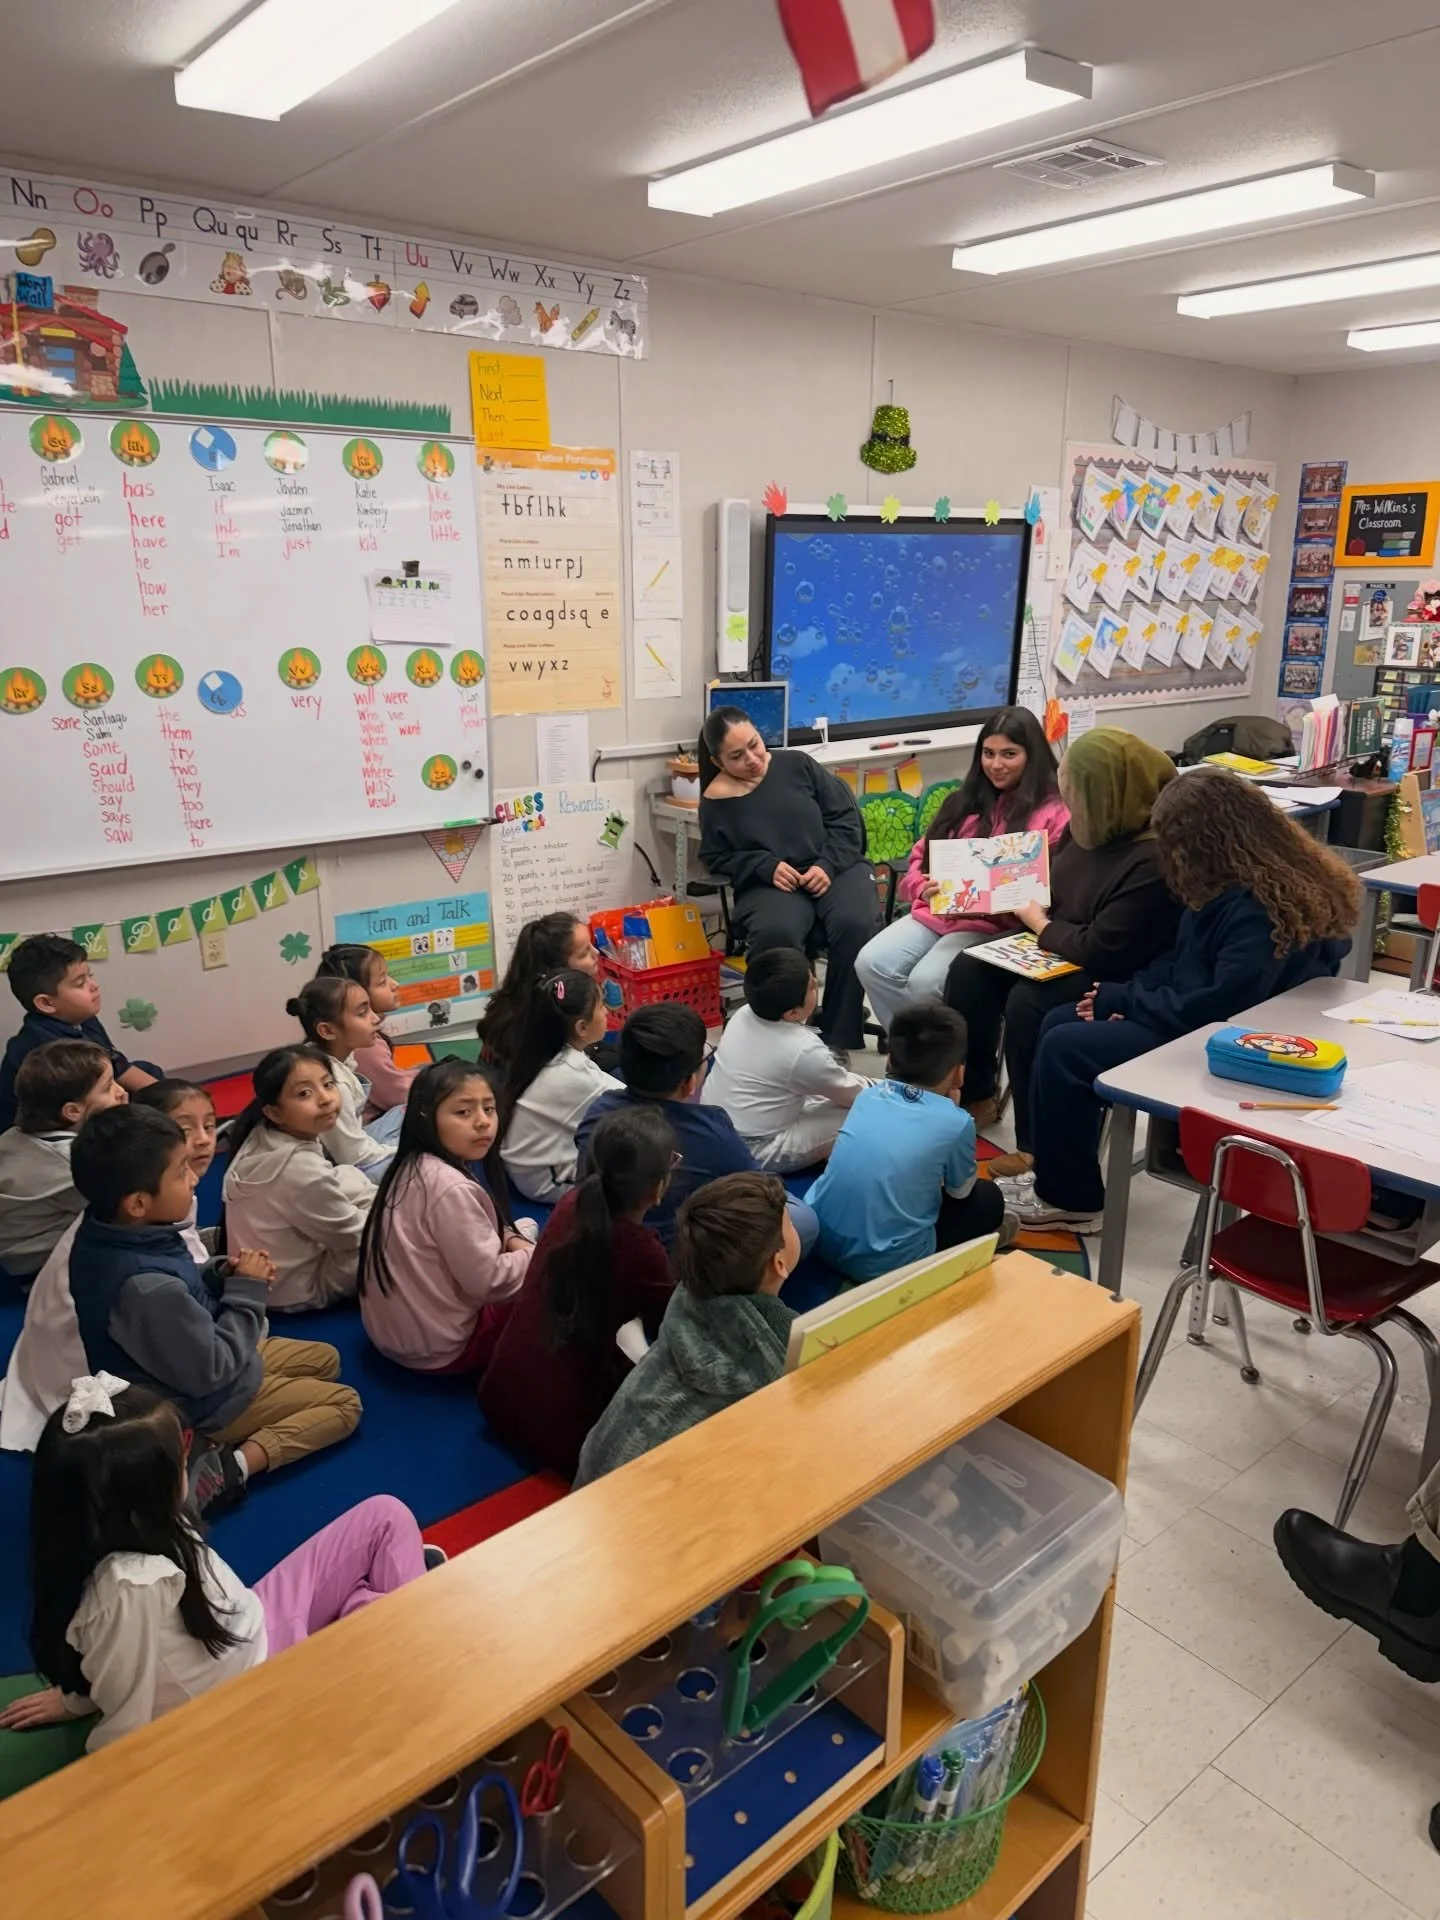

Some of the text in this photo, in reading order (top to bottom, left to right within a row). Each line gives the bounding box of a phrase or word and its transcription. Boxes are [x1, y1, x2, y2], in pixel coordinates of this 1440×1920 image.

[10, 177, 48, 209] Nn
[73, 186, 114, 218] Oo
[139, 197, 168, 238] Pp
[276, 219, 299, 247] Rr
[321, 227, 342, 254] Ss
[360, 234, 382, 261] Tt
[405, 241, 429, 269] Uu
[449, 249, 473, 275] Vv
[488, 255, 520, 283] Ww
[534, 263, 556, 289] Xx
[572, 271, 595, 304] Yy
[613, 278, 631, 300] Zz
[40, 465, 79, 486] Gabriel
[122, 471, 155, 499] has
[272, 477, 308, 499] Jayden
[127, 501, 166, 529] here
[429, 504, 453, 522] love
[55, 512, 84, 535] got
[431, 525, 461, 541] little
[1358, 517, 1402, 530] Classroom
[131, 528, 167, 549] have
[282, 536, 313, 561] just
[135, 550, 152, 569] he
[137, 572, 168, 595] how
[141, 597, 169, 617] her
[157, 705, 181, 722] the
[290, 694, 322, 721] very
[83, 710, 127, 730] Santiago
[160, 723, 192, 740] them
[169, 743, 195, 762] try
[169, 759, 197, 777] two
[176, 778, 202, 798] they
[180, 794, 203, 811] too
[495, 791, 544, 824] CLASS
[185, 812, 213, 831] there
[501, 846, 508, 854] 5
[502, 873, 513, 882] 20
[504, 887, 514, 896] 30
[406, 905, 430, 928] and
[437, 900, 472, 920] Talk
